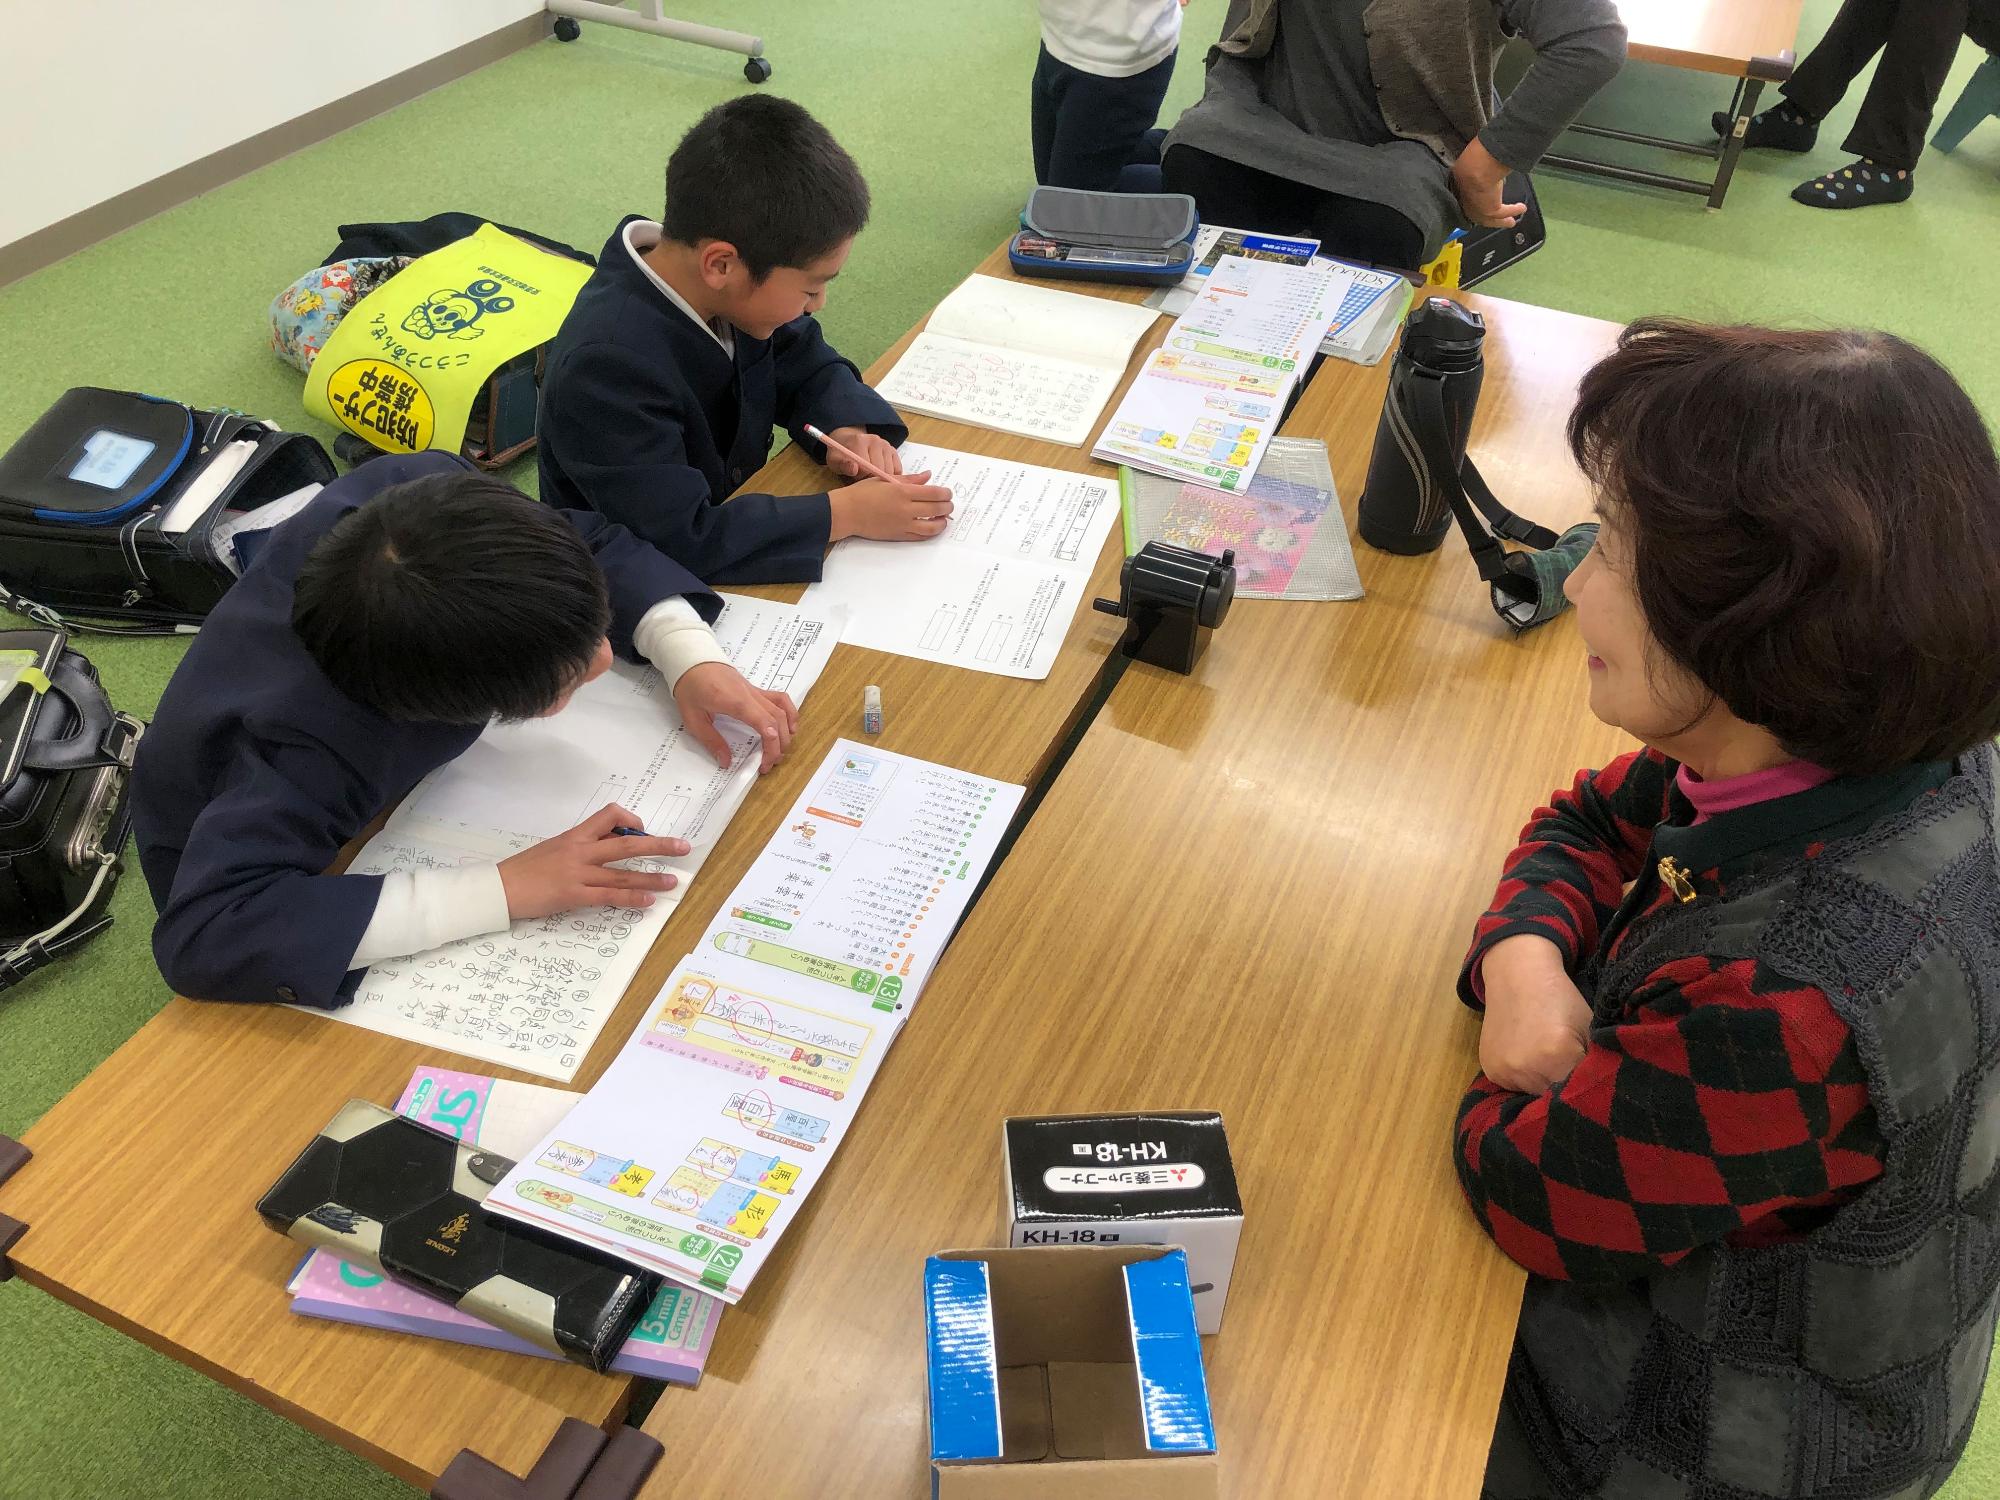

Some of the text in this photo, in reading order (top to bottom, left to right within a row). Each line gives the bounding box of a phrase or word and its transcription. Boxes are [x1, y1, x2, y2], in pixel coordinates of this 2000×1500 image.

[370, 312, 470, 369] こうつうあんぜん
[358, 366, 419, 412] 携帯中
[334, 392, 420, 451] 防犯ブザー
[802, 620, 818, 634] 31
[878, 979, 902, 999] 13
[1095, 1141, 1167, 1162] KH-18
[620, 1168, 645, 1186] 考
[769, 1166, 792, 1183] 馬
[1060, 1167, 1168, 1184] 三菱シャープナー
[742, 1203, 766, 1222] 形
[1023, 1230, 1096, 1244] KH-18
[711, 1245, 741, 1269] 12
[666, 1294, 695, 1342] Campus
